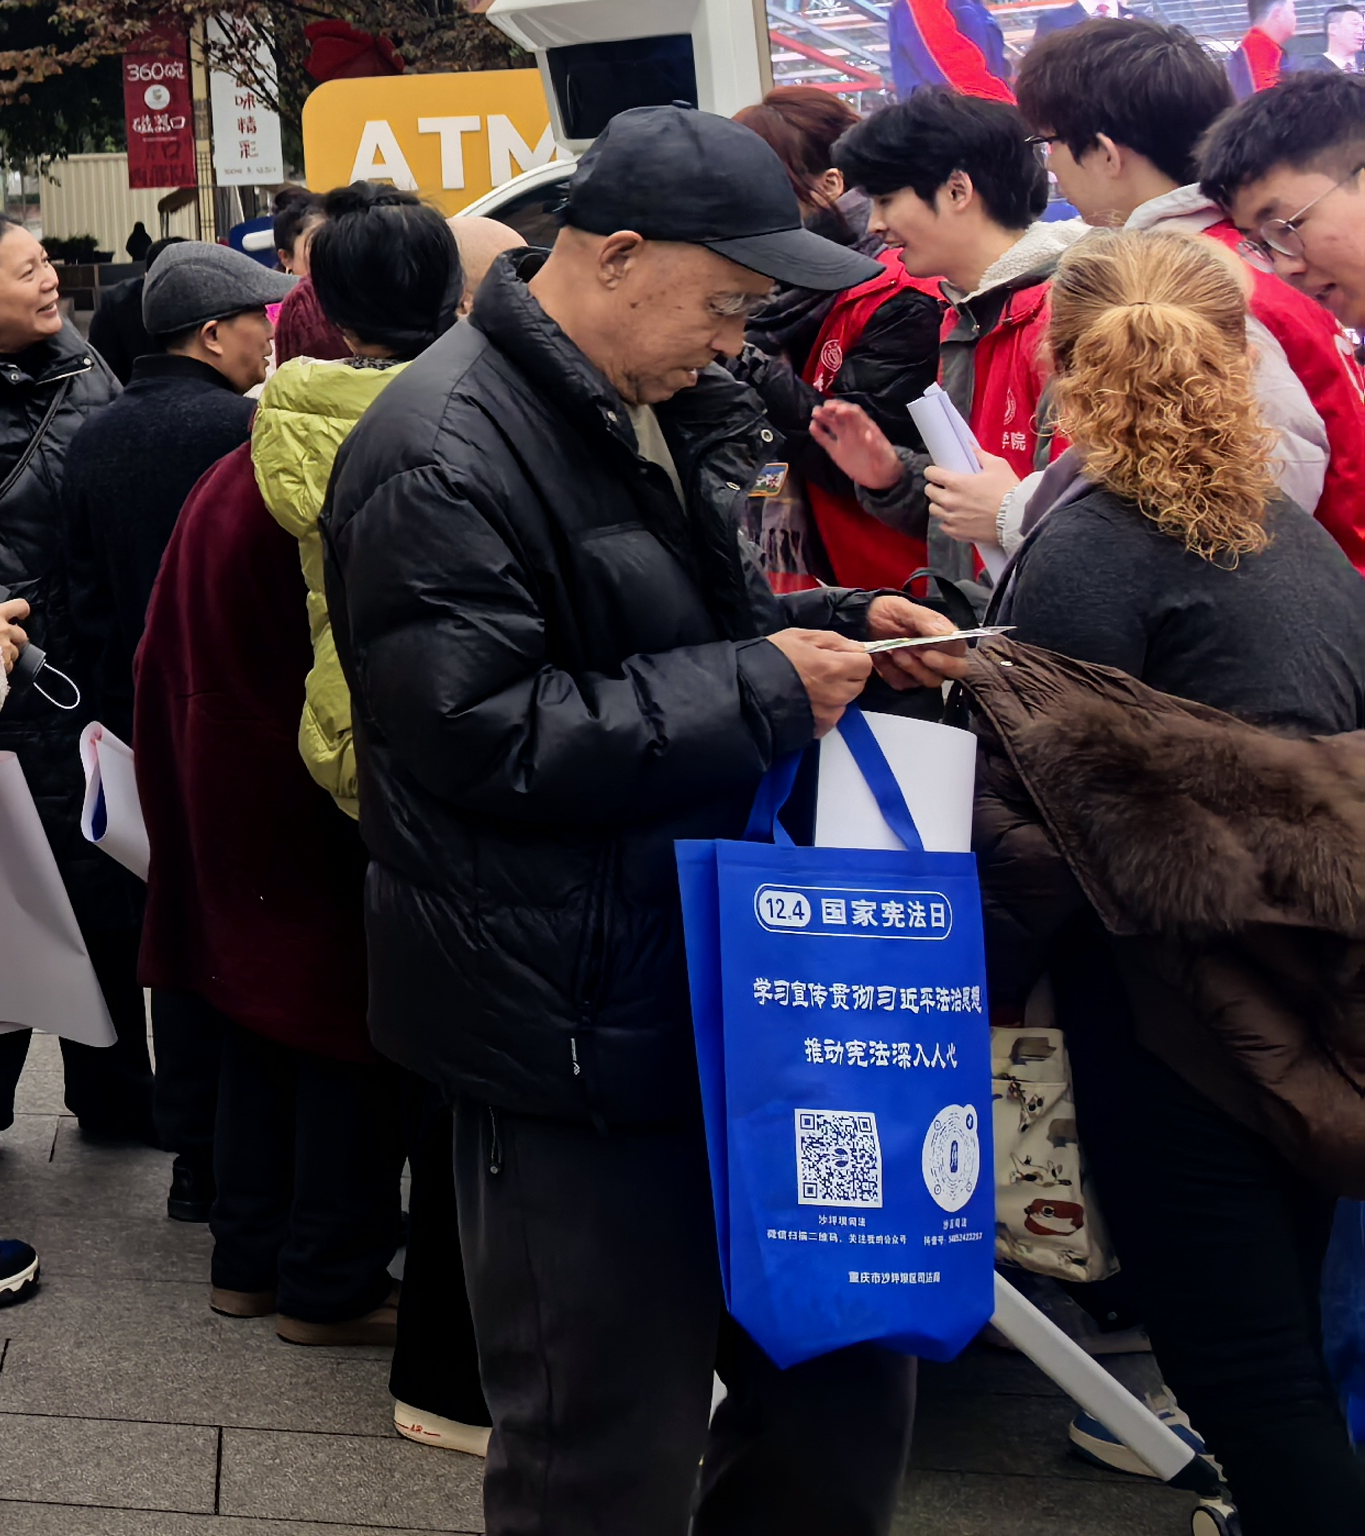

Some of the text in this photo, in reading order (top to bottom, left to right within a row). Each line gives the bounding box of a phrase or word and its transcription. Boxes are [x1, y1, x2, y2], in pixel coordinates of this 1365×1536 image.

[349, 114, 559, 191] ATM
[821, 897, 946, 928] 国家宪法日
[753, 977, 983, 1014] 学习宣传贯彻习近平法治思想
[804, 1037, 959, 1069] 推动宪法深入人心
